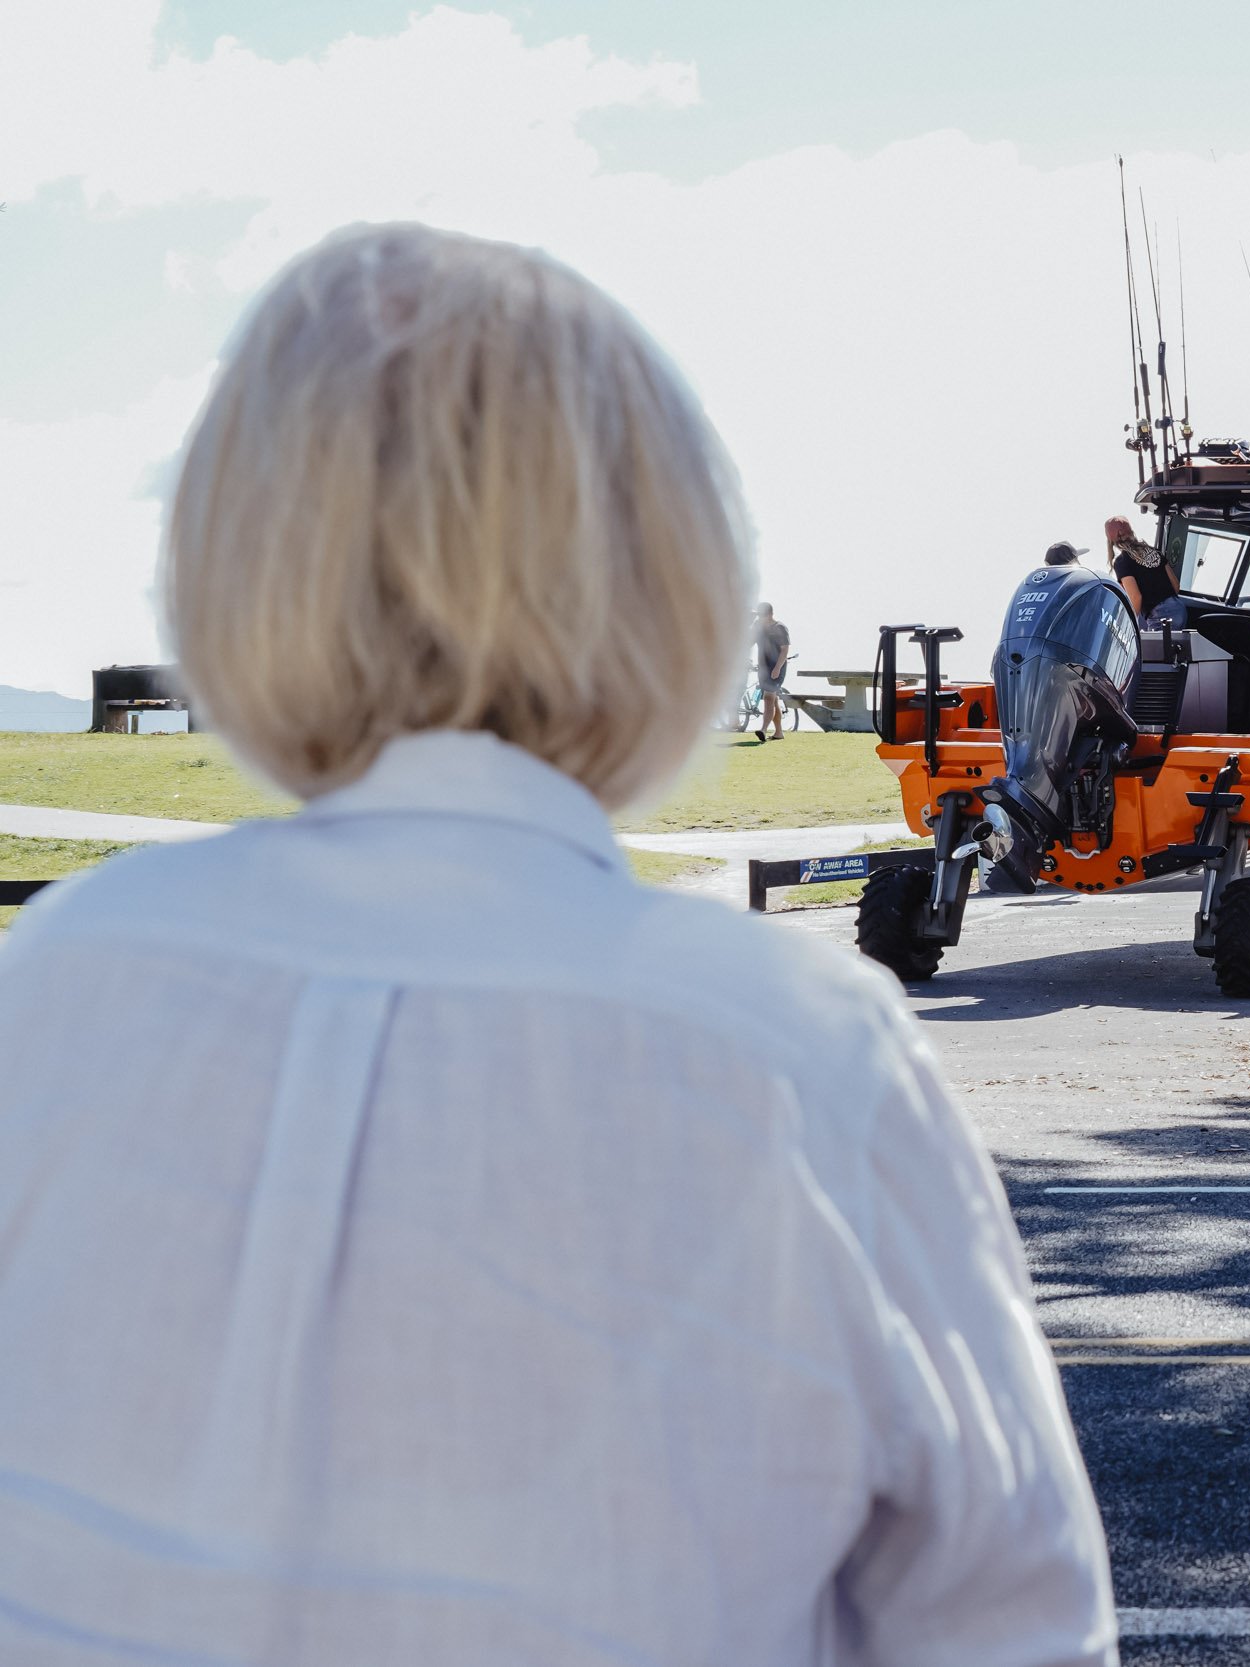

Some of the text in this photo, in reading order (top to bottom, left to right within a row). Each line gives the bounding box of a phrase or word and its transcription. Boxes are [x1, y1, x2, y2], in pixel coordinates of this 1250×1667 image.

[1016, 592, 1049, 604] 300
[1018, 608, 1036, 616] V6
[806, 859, 863, 870] OW AWAY AREA
